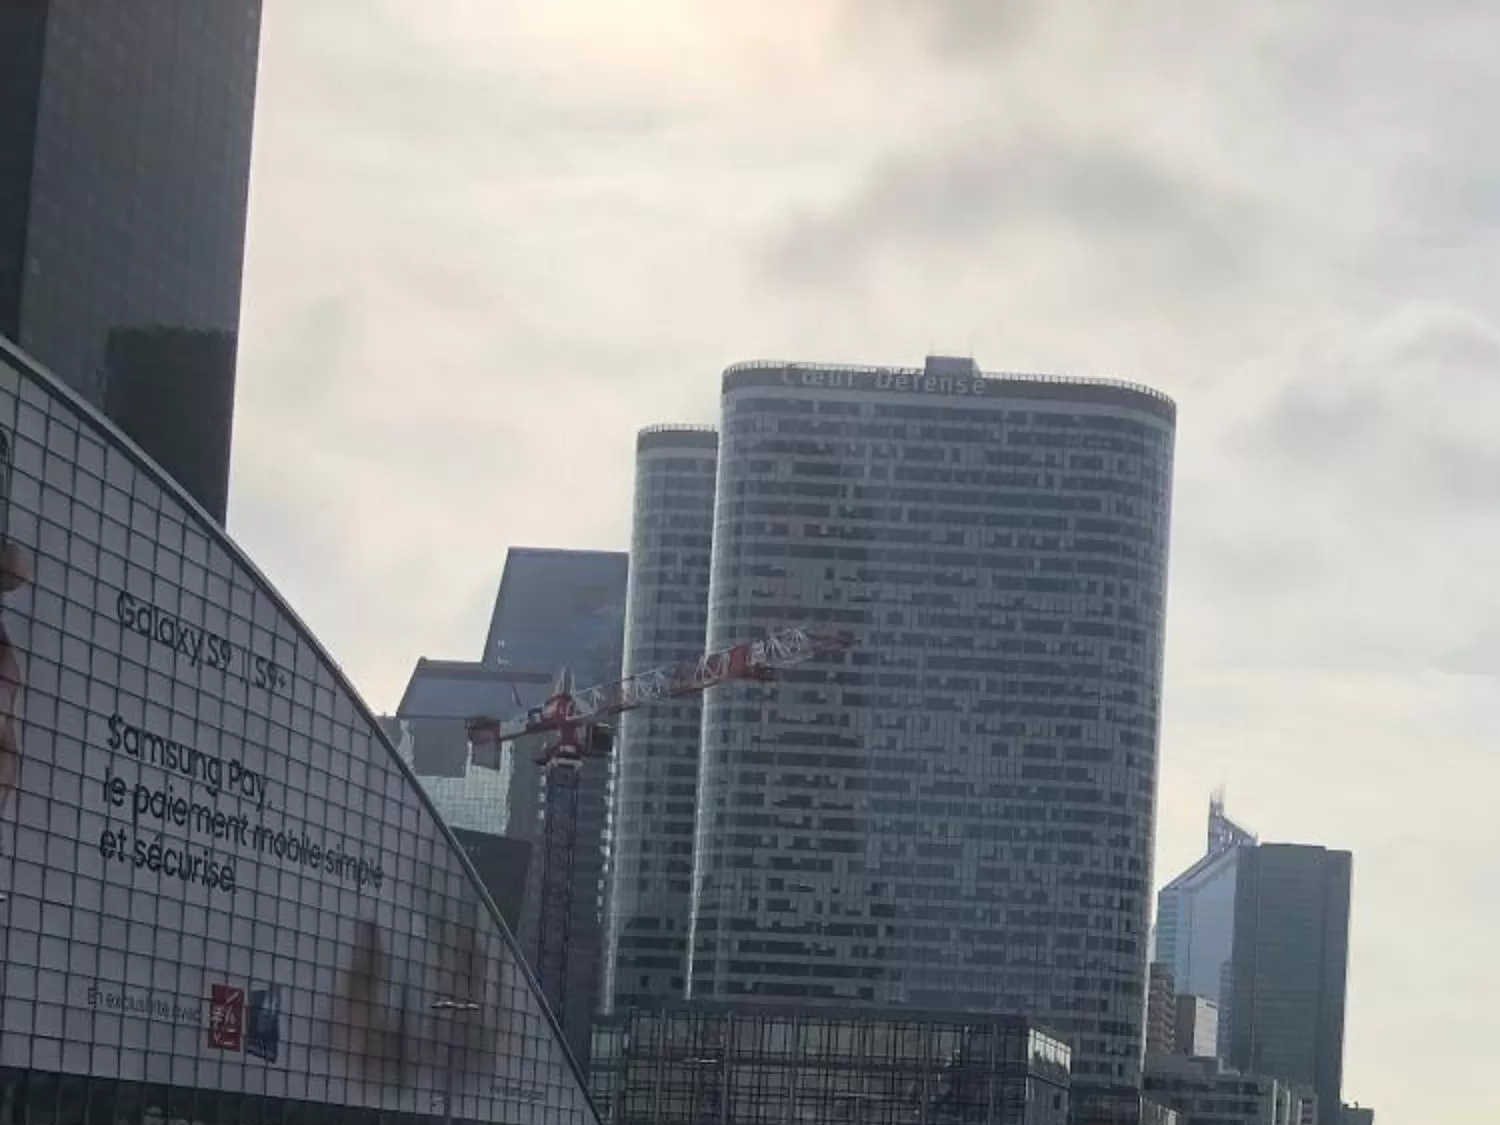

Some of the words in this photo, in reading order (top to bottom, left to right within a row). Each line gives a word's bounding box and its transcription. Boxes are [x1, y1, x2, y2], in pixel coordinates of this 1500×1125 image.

[117, 591, 203, 667] Galaxy
[207, 634, 231, 671] S9
[255, 656, 286, 691] S9+
[107, 713, 222, 797] Samsung
[99, 827, 127, 862] et
[104, 766, 127, 807] le
[133, 783, 248, 847] paiement
[252, 823, 321, 869] mobile
[325, 844, 384, 889] simple
